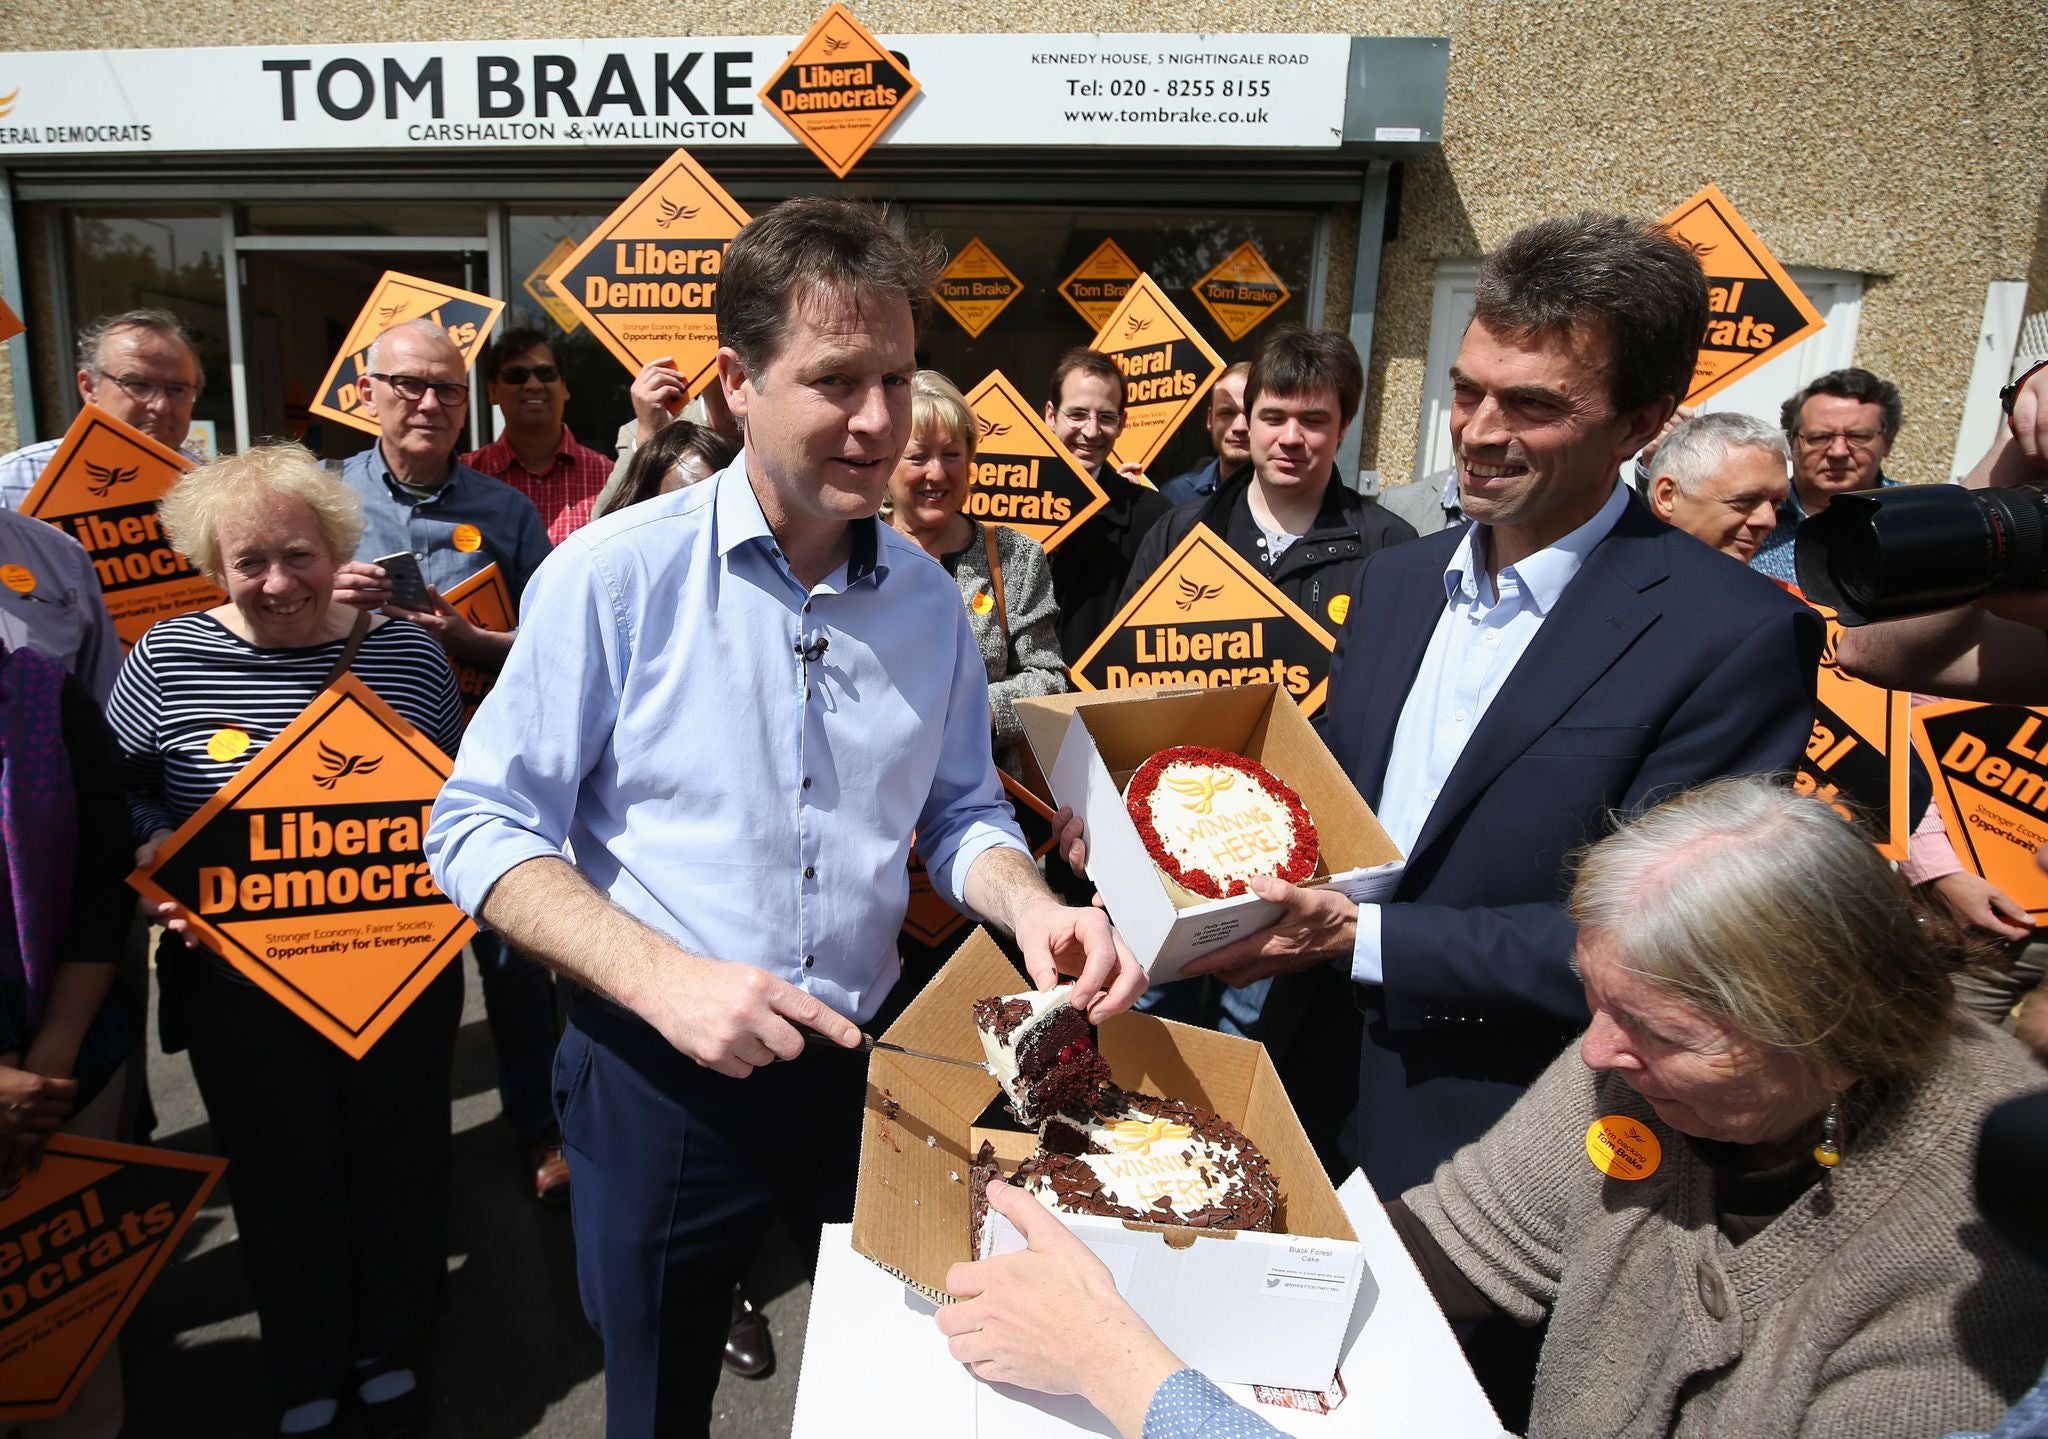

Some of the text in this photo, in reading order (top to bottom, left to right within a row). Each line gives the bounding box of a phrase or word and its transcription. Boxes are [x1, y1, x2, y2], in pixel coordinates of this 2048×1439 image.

[1031, 53, 1309, 66] KENNEDY HOUSE, 5 NIGHTINGALE ROAD
[261, 51, 755, 122] TOM BRAKE
[799, 63, 874, 89] Liberal
[1066, 79, 1104, 97] Tel:
[1110, 79, 1147, 97] 020
[1166, 79, 1216, 97] 8255
[1222, 79, 1271, 97] 8155
[780, 84, 898, 112] Democrats
[1064, 107, 1269, 124] www.tombrake.co.uk
[45, 124, 153, 144] DEMOCRATS
[408, 121, 747, 141] CARSHALTON & WALLINGTON
[942, 281, 1012, 296] Tom Brake
[1072, 283, 1101, 297] Tom
[1206, 284, 1278, 302] Tom Brake
[622, 333, 672, 342] Opportunity
[674, 332, 686, 340] for
[962, 490, 1072, 522] ocrats
[52, 511, 171, 553] iber
[1136, 622, 1264, 664] Liberal
[1106, 658, 1311, 695] Democrats
[1175, 806, 1273, 842] WINNING
[1207, 825, 1283, 868] HERE!
[265, 919, 436, 945] Stronger Economy. Fairer Society.
[266, 932, 436, 960] Opportunity for Everyone.
[1597, 1131, 1616, 1150] Tom
[1616, 1147, 1643, 1171] Brake
[1603, 1127, 1617, 1140] I'm
[1616, 1138, 1648, 1164] backing
[1289, 1246, 1333, 1257] Black Forest
[1301, 1255, 1320, 1264] Cake
